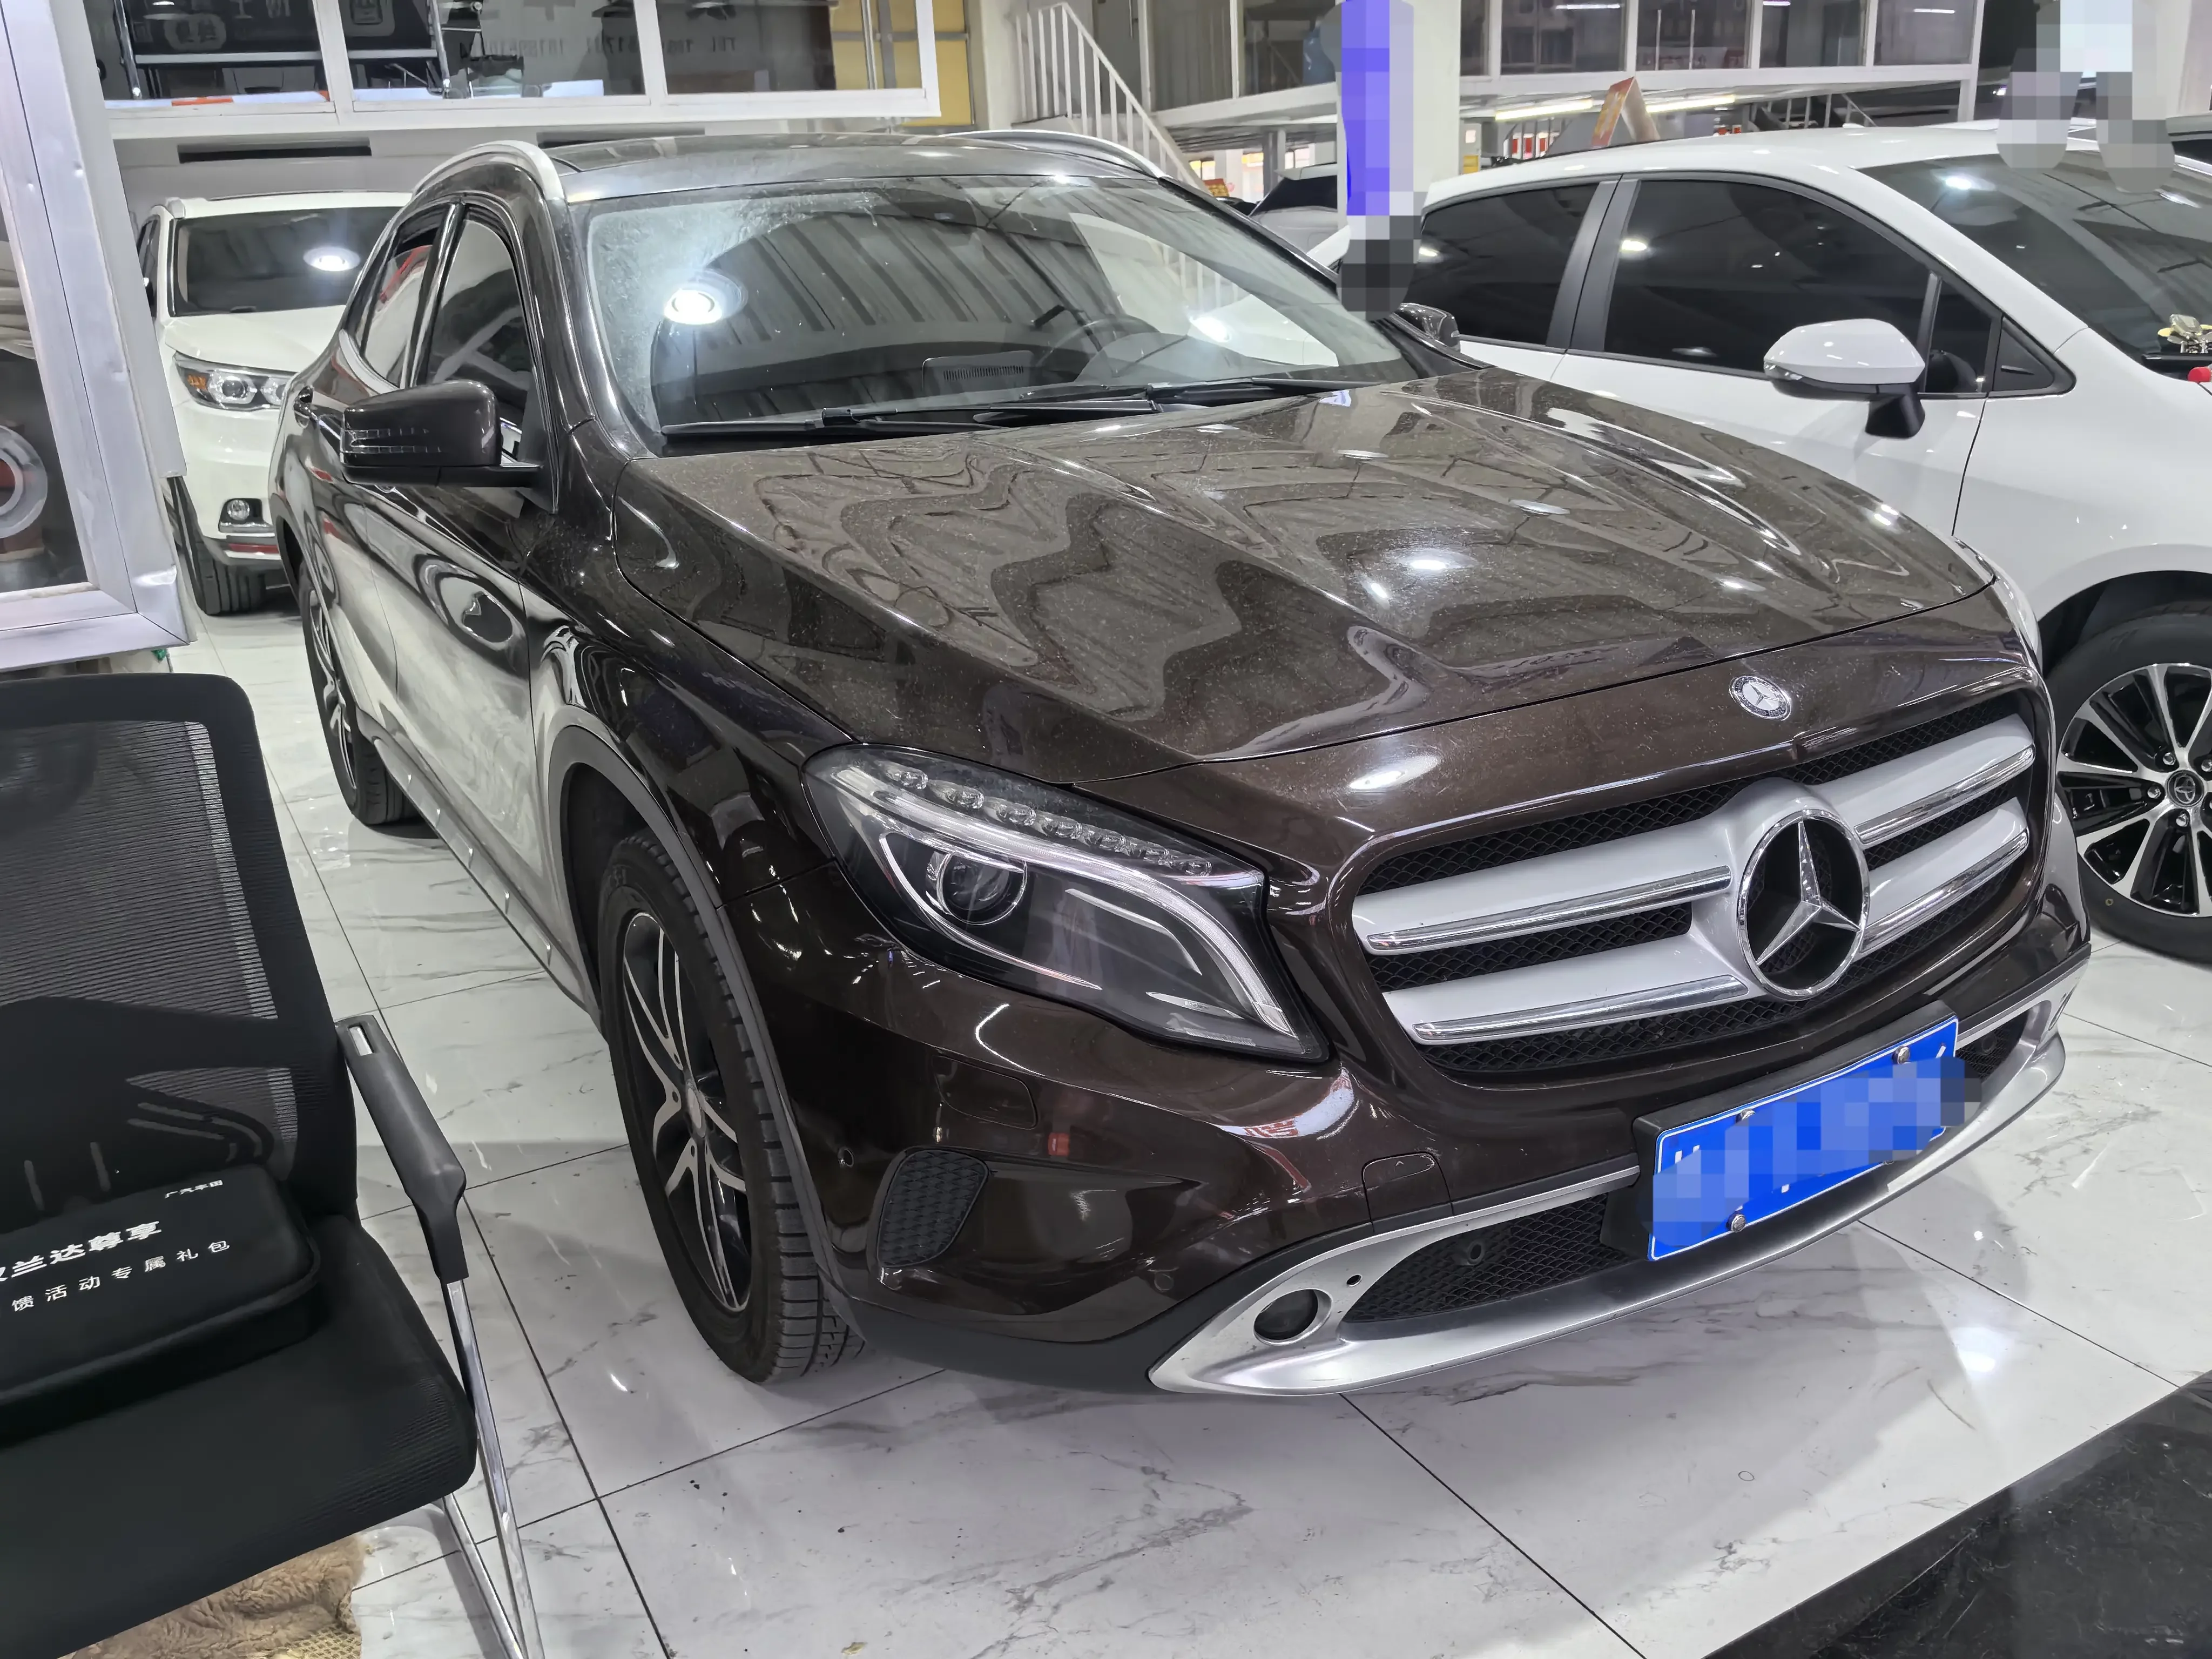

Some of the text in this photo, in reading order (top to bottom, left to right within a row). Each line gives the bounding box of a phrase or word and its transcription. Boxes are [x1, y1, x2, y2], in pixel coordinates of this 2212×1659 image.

[0, 1220, 163, 1282] 兰达尊享
[11, 1240, 230, 1312] 馈活动专属礼包
